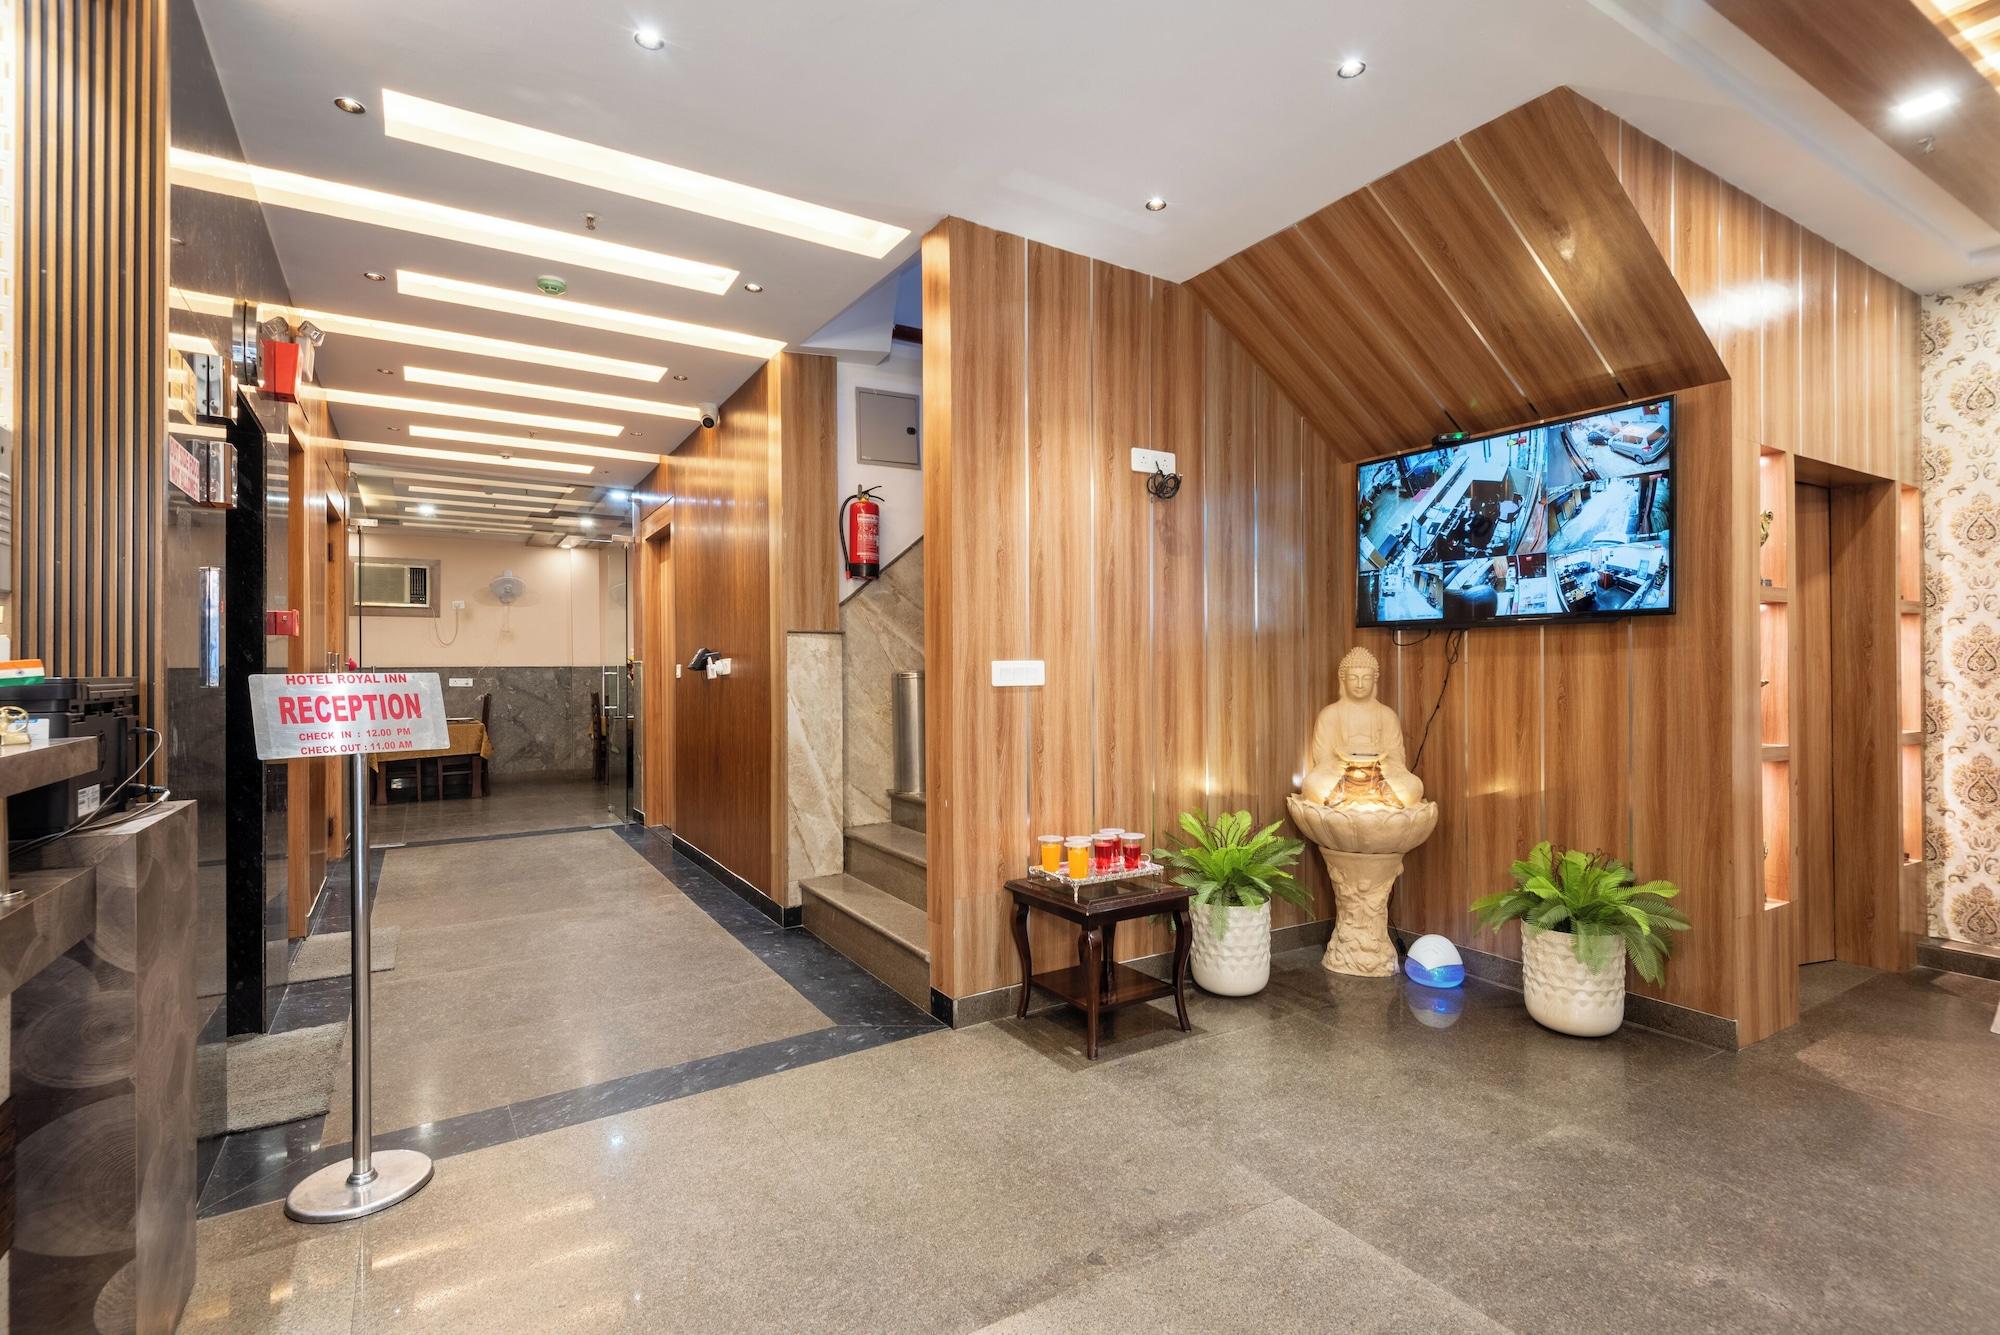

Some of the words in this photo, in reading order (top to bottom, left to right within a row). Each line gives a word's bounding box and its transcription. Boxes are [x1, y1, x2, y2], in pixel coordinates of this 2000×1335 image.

[285, 674, 333, 686] HOTEL
[337, 674, 381, 684] ROYAL
[384, 673, 408, 684] INN
[278, 693, 423, 725] RECEPTION
[298, 731, 335, 741] CHECK
[341, 730, 352, 739] IN
[366, 729, 392, 738] 12.00
[396, 727, 411, 736] PM
[300, 745, 337, 755] CHECK
[340, 744, 361, 752] OUT
[370, 742, 396, 750] 11.00
[398, 740, 413, 749] AM
